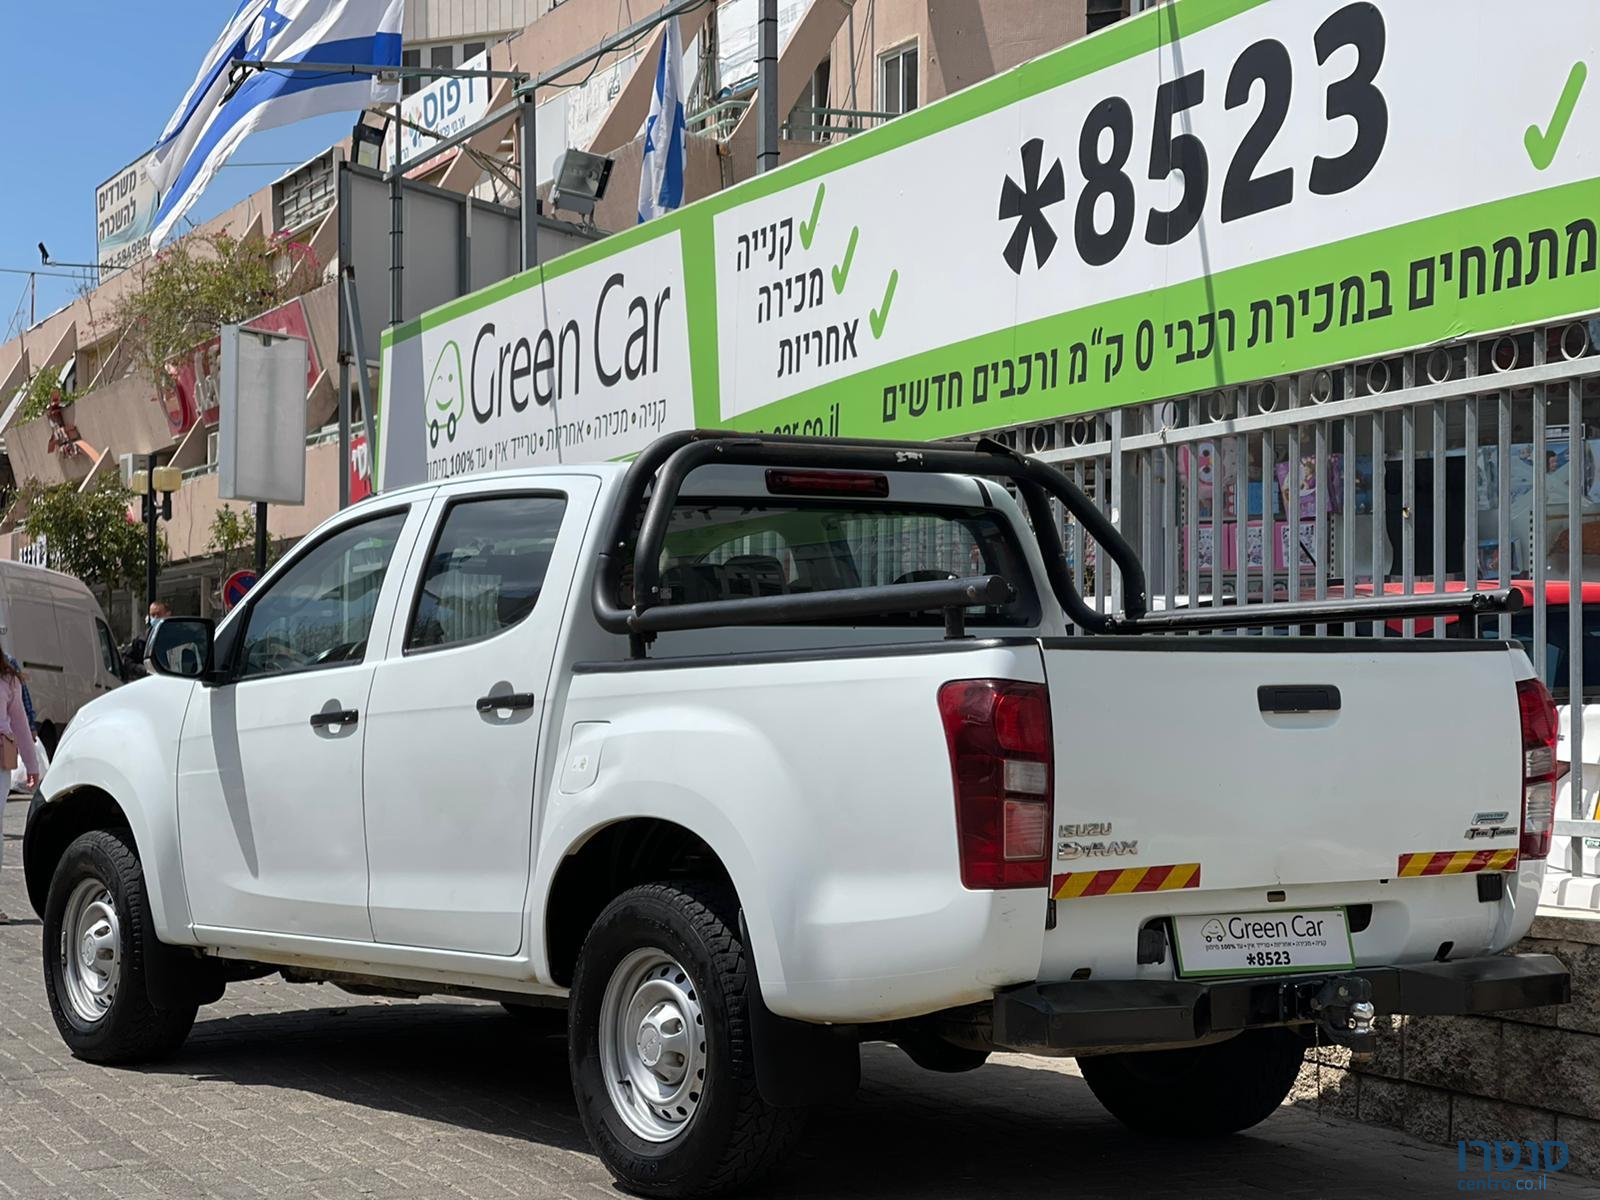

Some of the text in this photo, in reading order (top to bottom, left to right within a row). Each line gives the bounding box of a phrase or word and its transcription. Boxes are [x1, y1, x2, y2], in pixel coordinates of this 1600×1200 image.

[99, 169, 137, 213] משרדים
[99, 195, 137, 240] להשכרה
[736, 216, 794, 272] קנייה
[1408, 217, 1598, 311] מתמחים
[757, 267, 824, 324] מכירה
[1247, 269, 1393, 349] במכירת
[470, 272, 671, 425] Green Car
[777, 318, 859, 378] אחריות
[1135, 319, 1155, 372] 0
[1164, 308, 1236, 365] רכבי
[882, 370, 963, 423] חדשים
[972, 348, 1058, 405] ורכבים
[546, 420, 585, 451] אחריות
[593, 408, 628, 440] מכירה
[638, 399, 667, 432] קניה
[450, 448, 475, 476] 100%
[475, 446, 487, 469] עד
[494, 439, 508, 471] אין
[1058, 822, 1112, 839] ISUZU
[1228, 915, 1324, 940] Green Car
